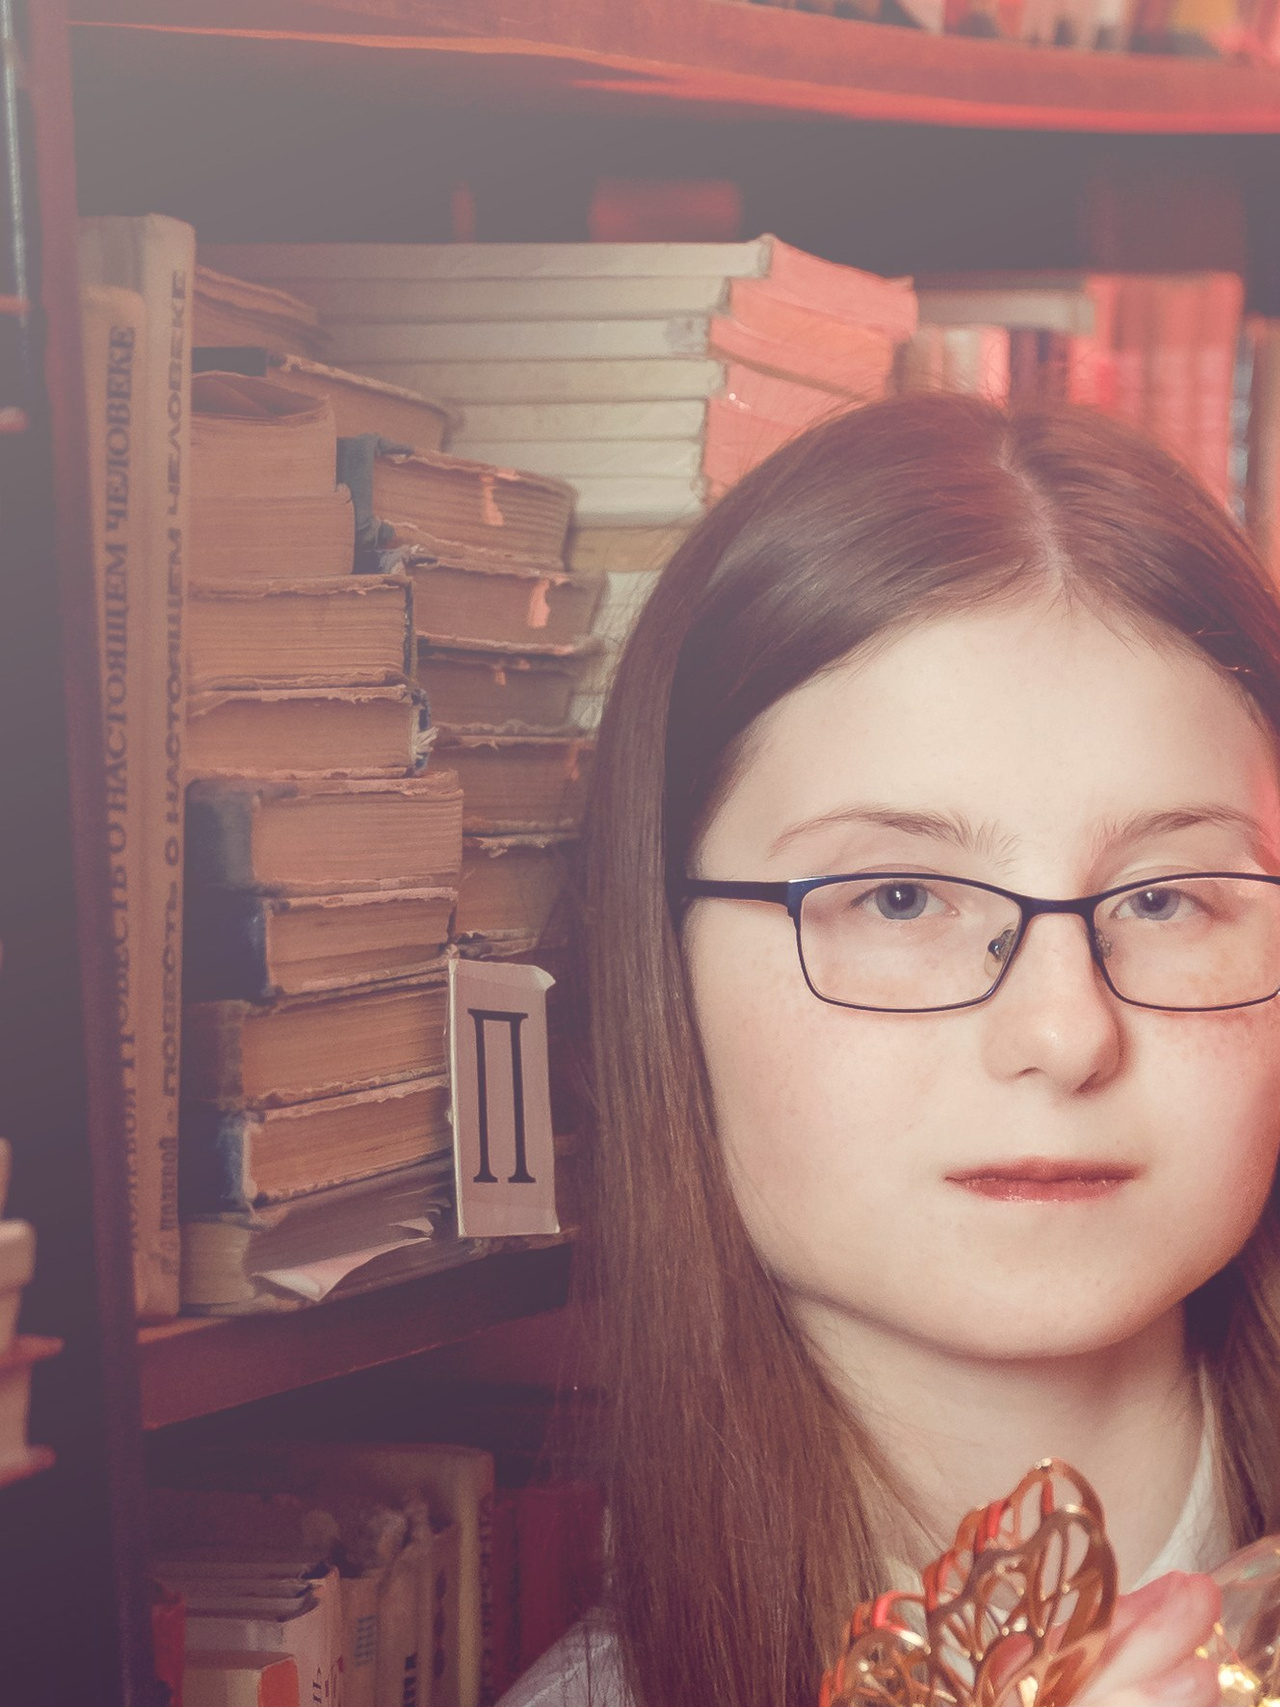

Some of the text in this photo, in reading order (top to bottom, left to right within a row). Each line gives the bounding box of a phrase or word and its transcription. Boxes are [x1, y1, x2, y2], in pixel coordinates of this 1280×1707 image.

[105, 326, 134, 531] ЧЕЛОВЕКЕ
[166, 268, 186, 516] ЧЕЛОВЕКЕ
[104, 544, 129, 814] НАСТОЯЩЕМ
[164, 528, 183, 824] НАСТОЯЩЕМ
[164, 836, 180, 867] О
[161, 882, 179, 1098] ПОВЕСТЬ
[467, 1008, 536, 1183] П
